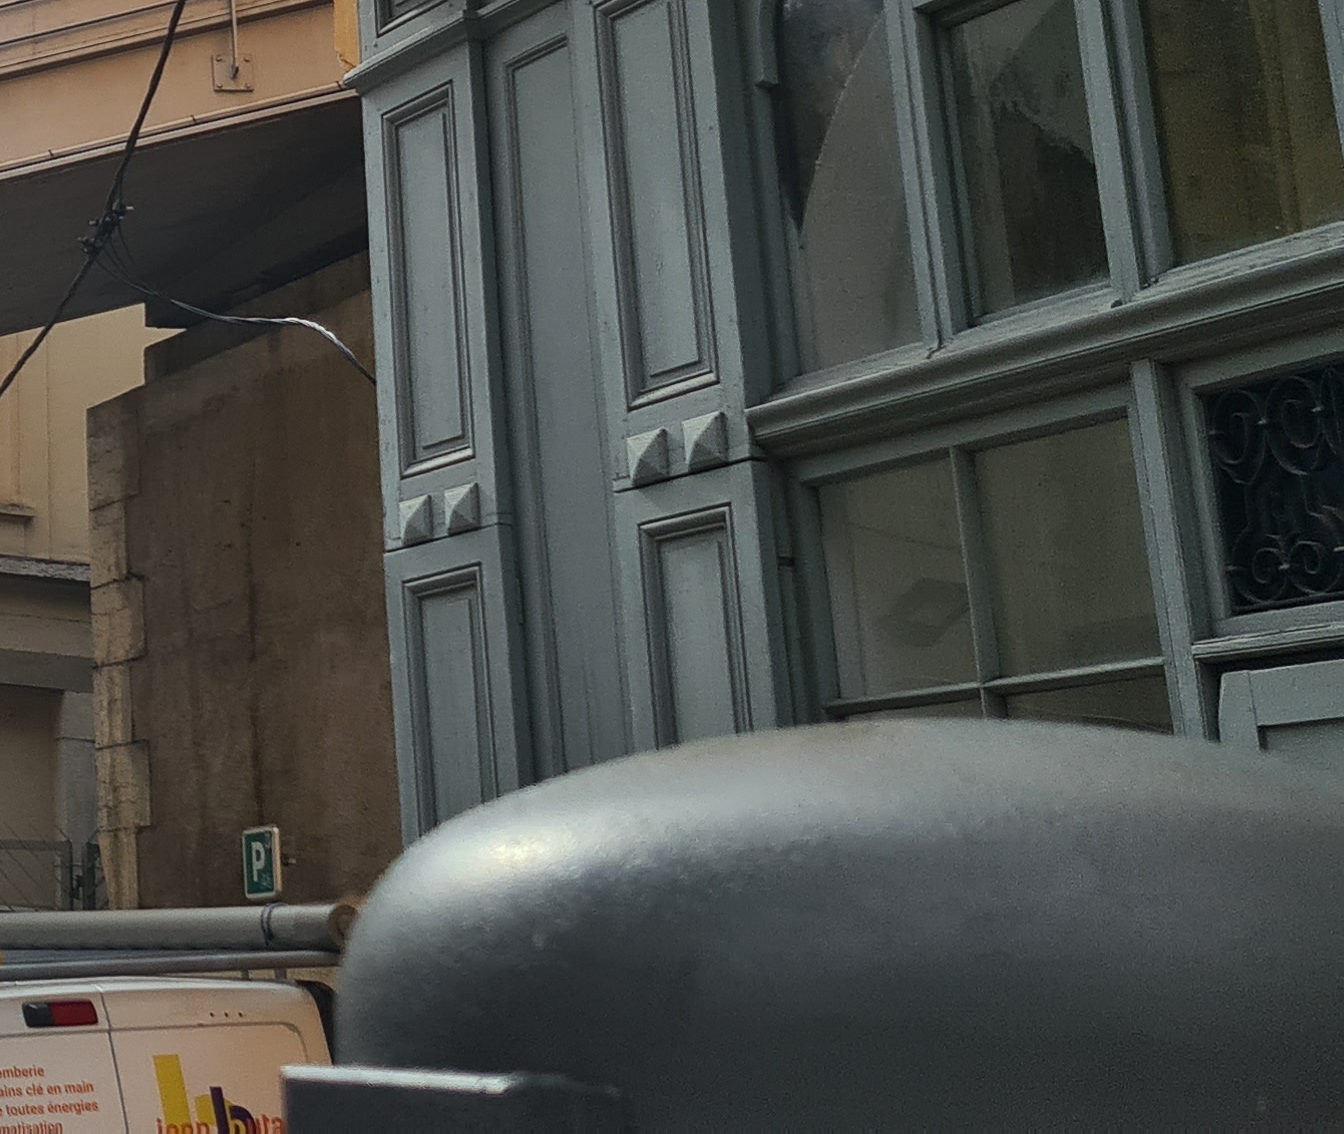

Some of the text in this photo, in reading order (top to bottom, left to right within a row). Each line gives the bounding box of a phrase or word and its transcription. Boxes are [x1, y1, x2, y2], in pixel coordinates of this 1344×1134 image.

[250, 841, 266, 883] P
[25, 1082, 44, 1097] clé
[47, 1084, 62, 1096] en
[64, 1079, 94, 1095] main
[5, 1102, 45, 1117] toutes
[47, 1099, 99, 1116] énergies
